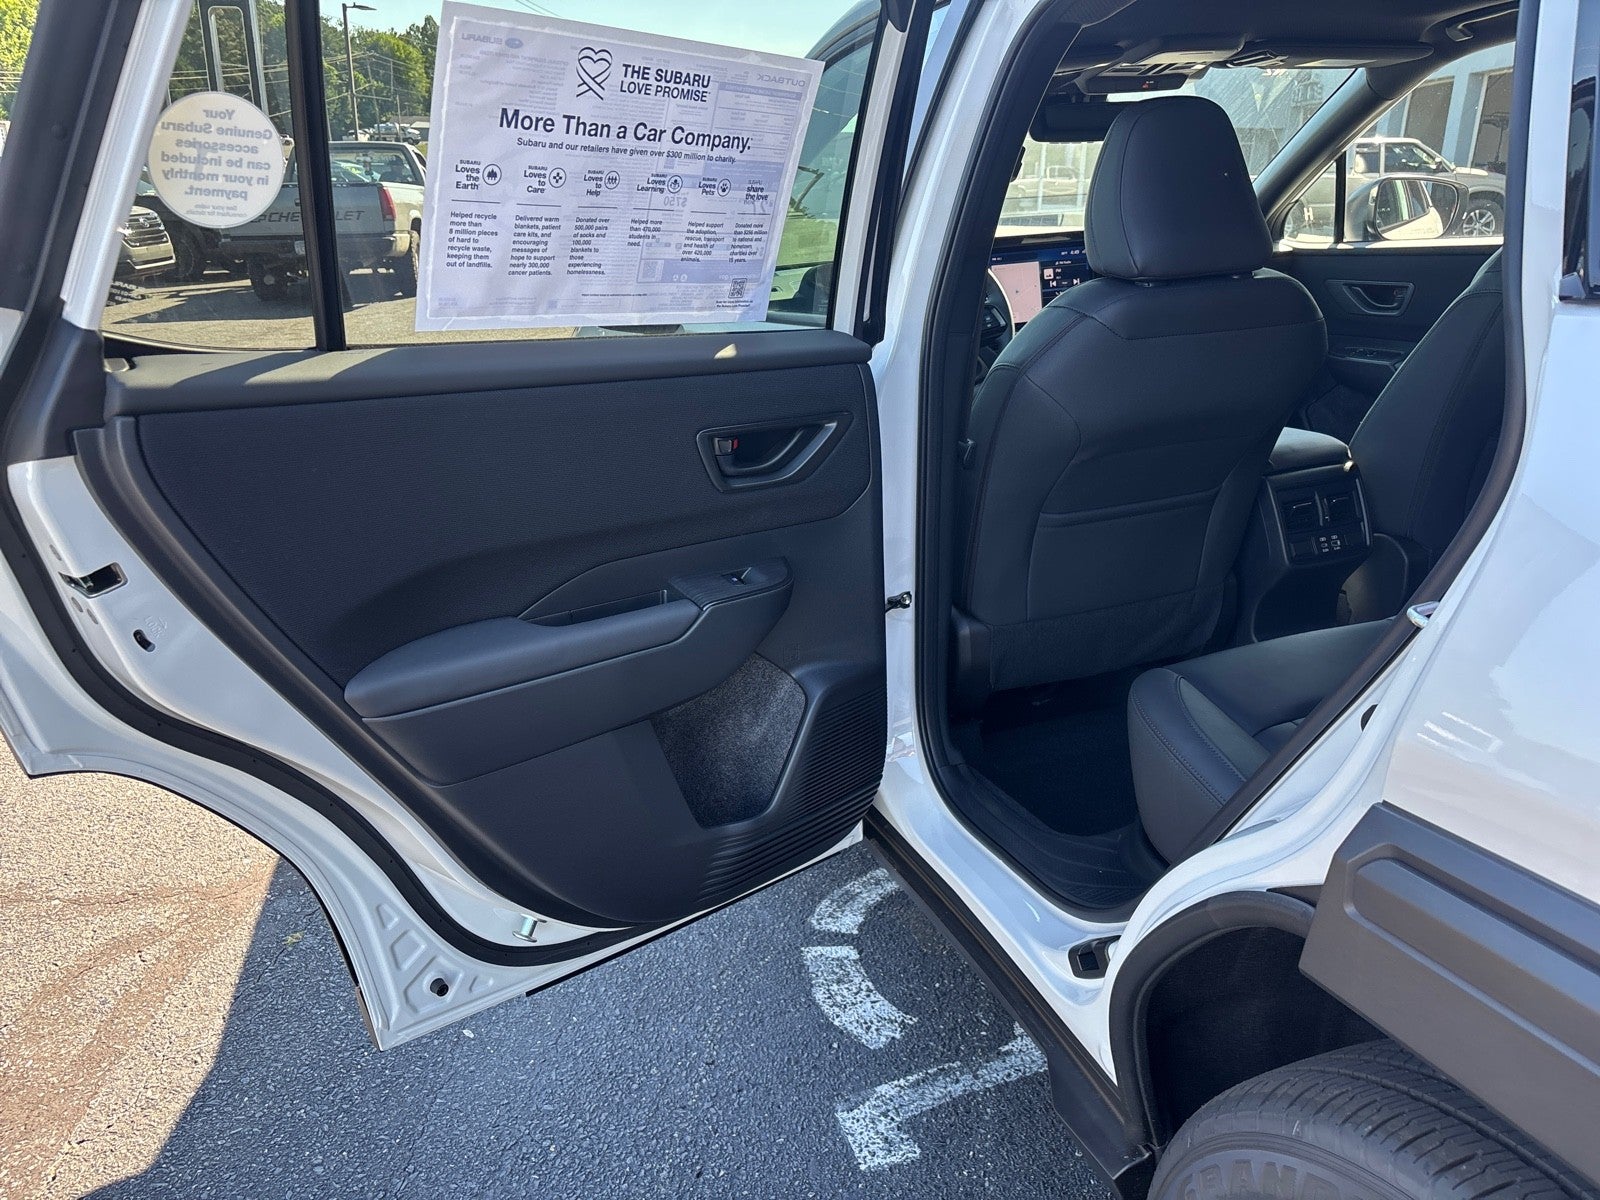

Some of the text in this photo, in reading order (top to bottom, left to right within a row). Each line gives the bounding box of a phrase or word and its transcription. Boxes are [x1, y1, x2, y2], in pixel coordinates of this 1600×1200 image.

[622, 63, 651, 81] THE
[654, 68, 711, 88] SUBARU
[620, 80, 652, 96] LOVE
[654, 85, 709, 102] PROMISE
[499, 107, 555, 133] More
[562, 114, 611, 139] Than
[616, 125, 628, 140] a
[633, 122, 666, 143] Car
[671, 126, 753, 154] Company.
[516, 137, 737, 164] Subaru and our retailers have given over $300 million to charity.
[455, 164, 480, 174] Loves
[466, 174, 479, 182] the
[524, 170, 547, 179] Loves
[584, 174, 604, 183] Loves
[455, 181, 479, 190] Earth
[647, 178, 666, 186] Loves
[527, 186, 545, 194] Care
[586, 189, 601, 197] Help
[637, 184, 665, 194] Learning
[747, 185, 765, 193] share
[745, 192, 769, 201] the love
[266, 210, 365, 222] CHELET
[474, 213, 497, 221] recycle
[512, 239, 548, 247] encouraging
[447, 253, 472, 261] keeping
